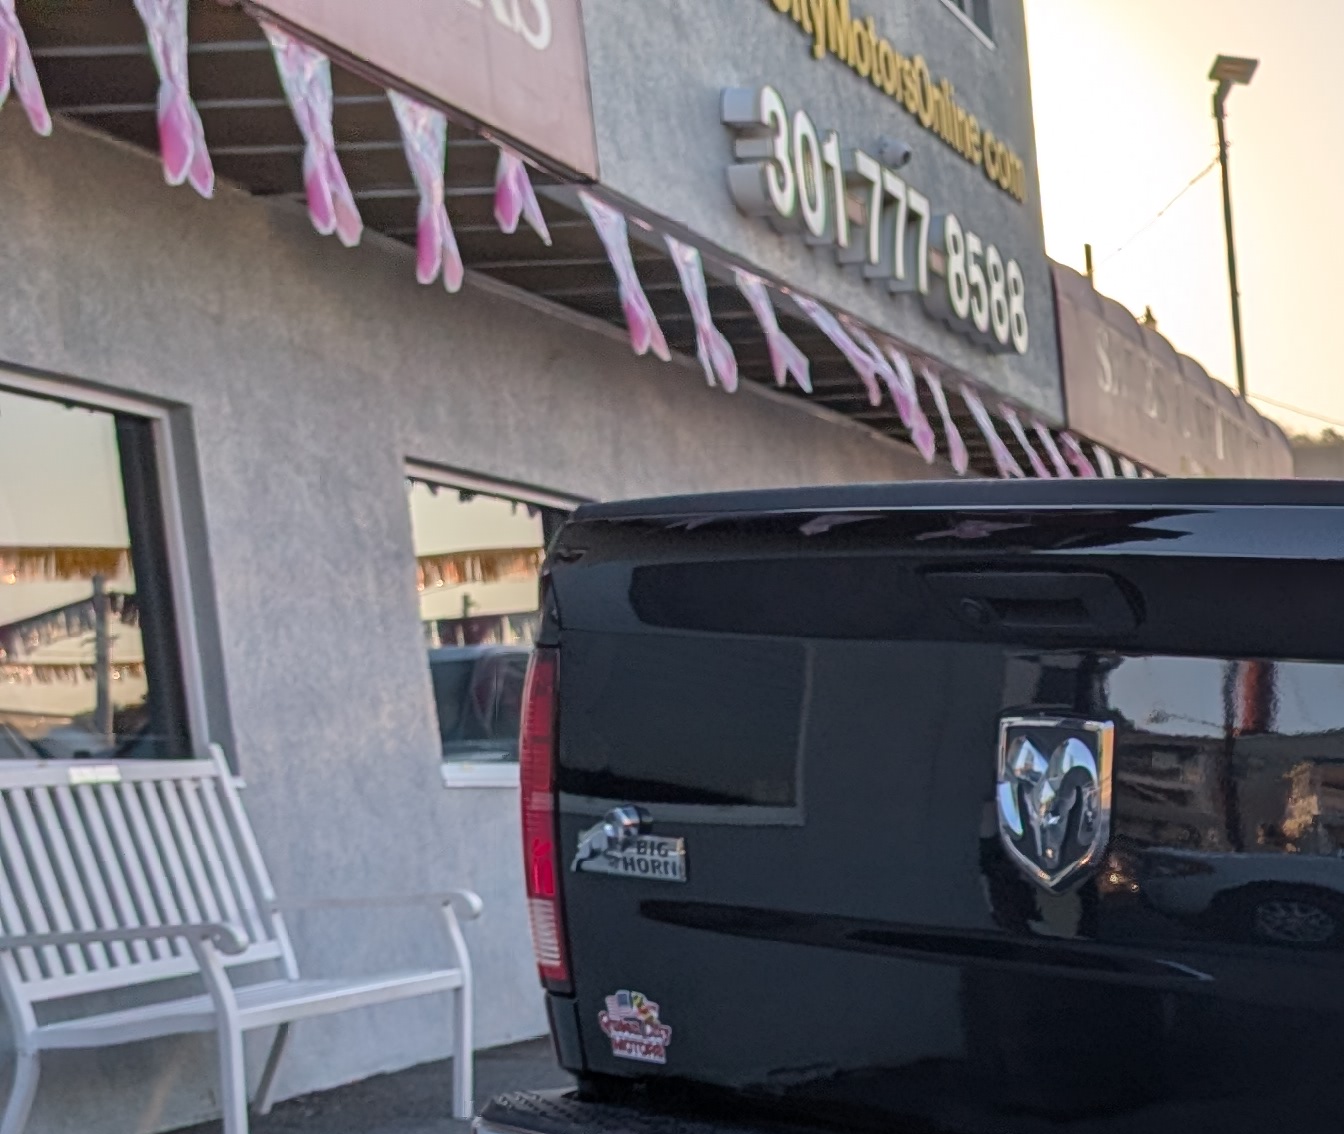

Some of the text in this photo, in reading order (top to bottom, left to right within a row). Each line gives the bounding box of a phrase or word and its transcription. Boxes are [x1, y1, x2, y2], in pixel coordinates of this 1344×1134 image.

[772, 0, 983, 166] tyMotorsOnline
[760, 85, 1029, 355] 301-777-8588
[622, 856, 677, 876] HORN
[636, 840, 669, 857] BIG
